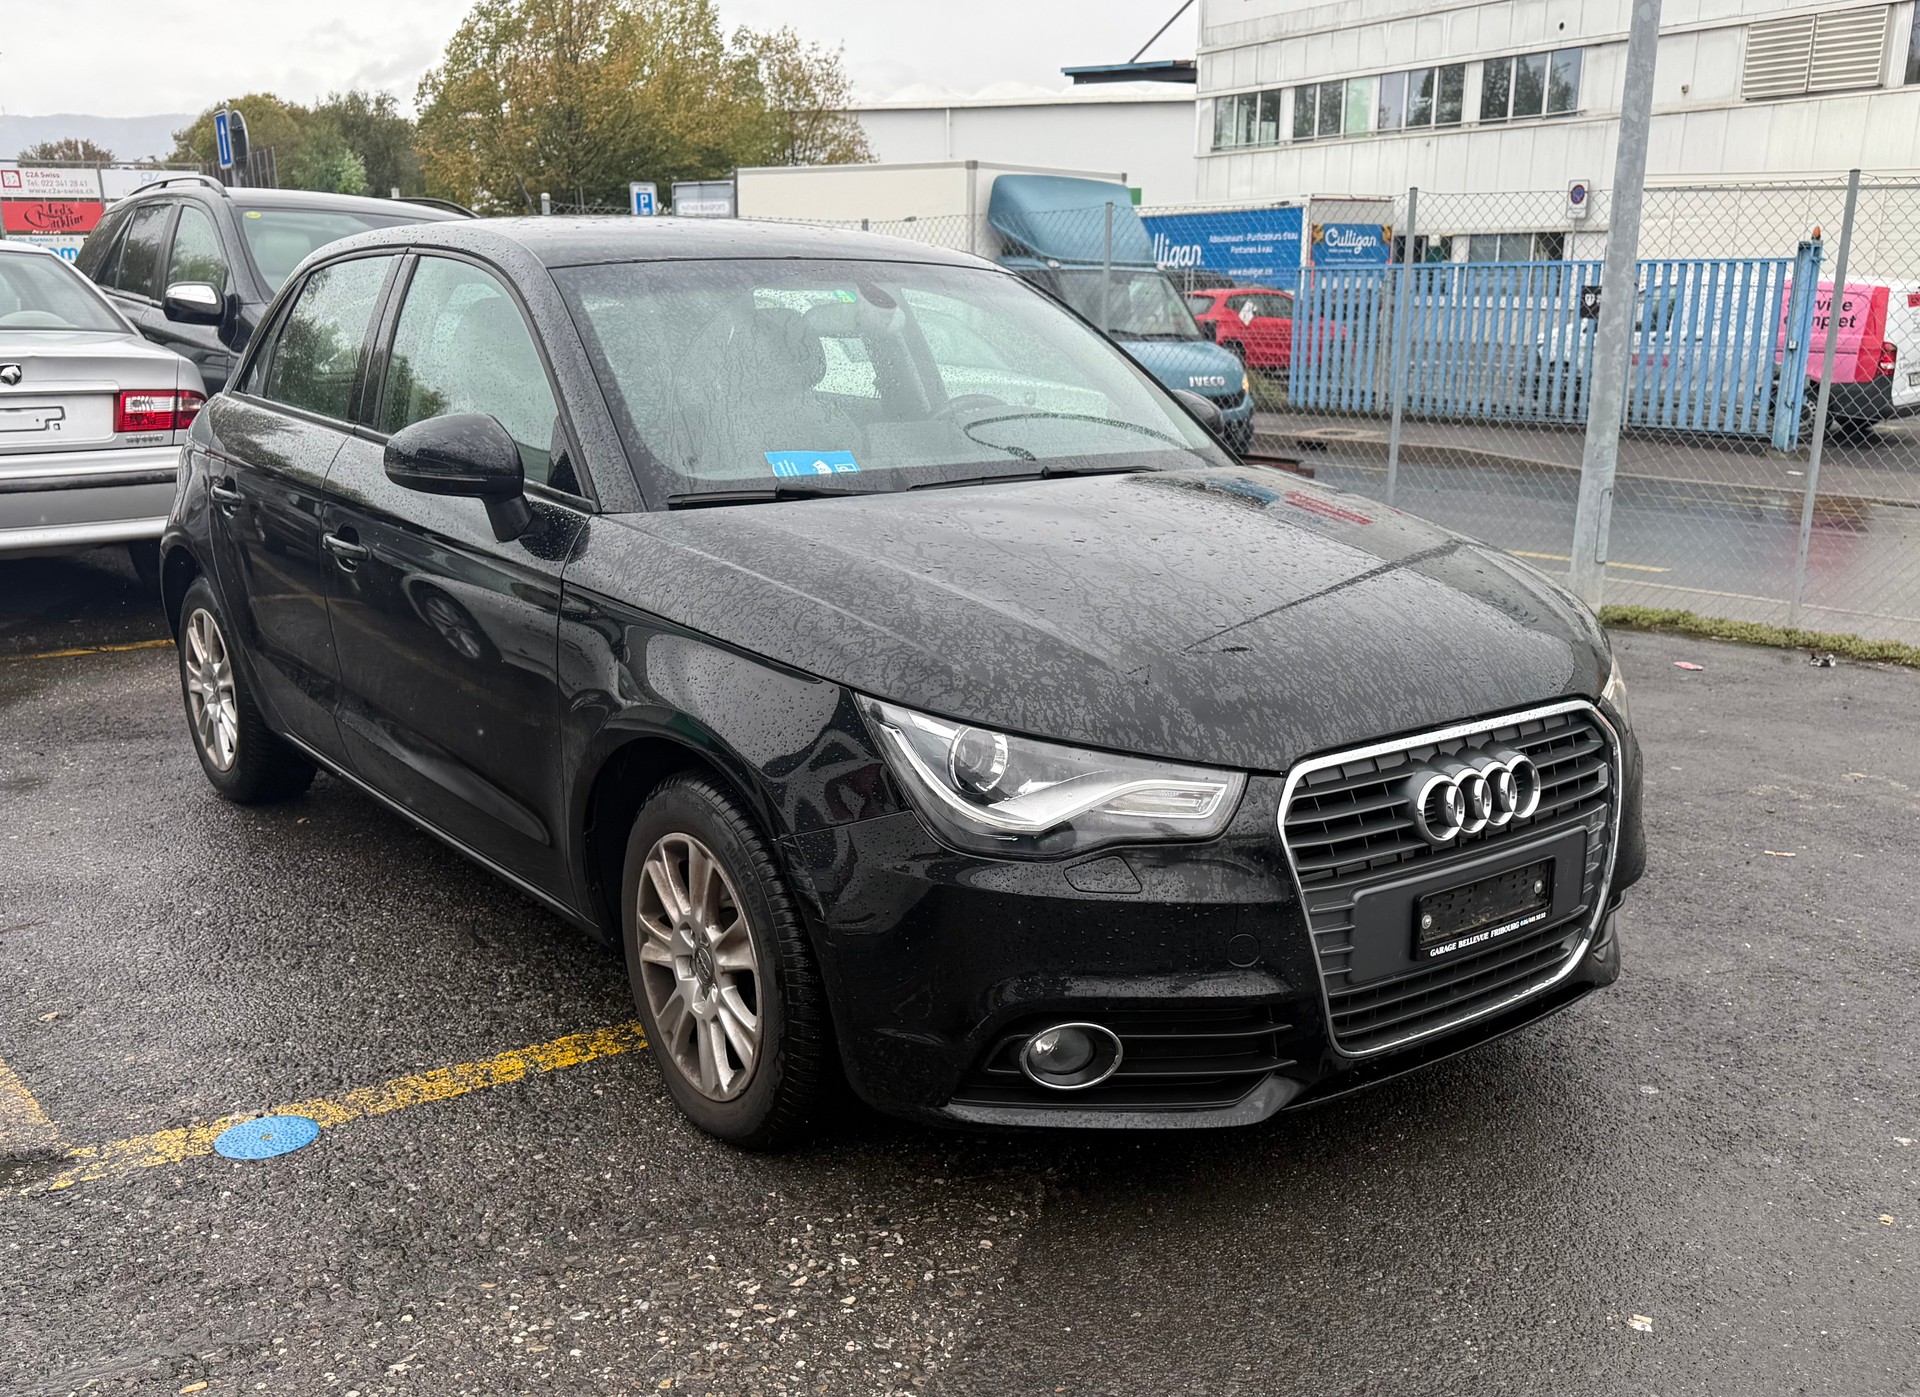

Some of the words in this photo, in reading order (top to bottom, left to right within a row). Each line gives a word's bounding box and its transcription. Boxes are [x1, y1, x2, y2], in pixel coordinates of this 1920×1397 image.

[1153, 233, 1203, 269] lligan
[1325, 227, 1377, 255] Culligan
[1189, 376, 1225, 387] IVECO
[1429, 942, 1457, 957] GARAGE
[1458, 932, 1489, 949] BELLEVUE
[1490, 921, 1520, 938] FRIBOURG
